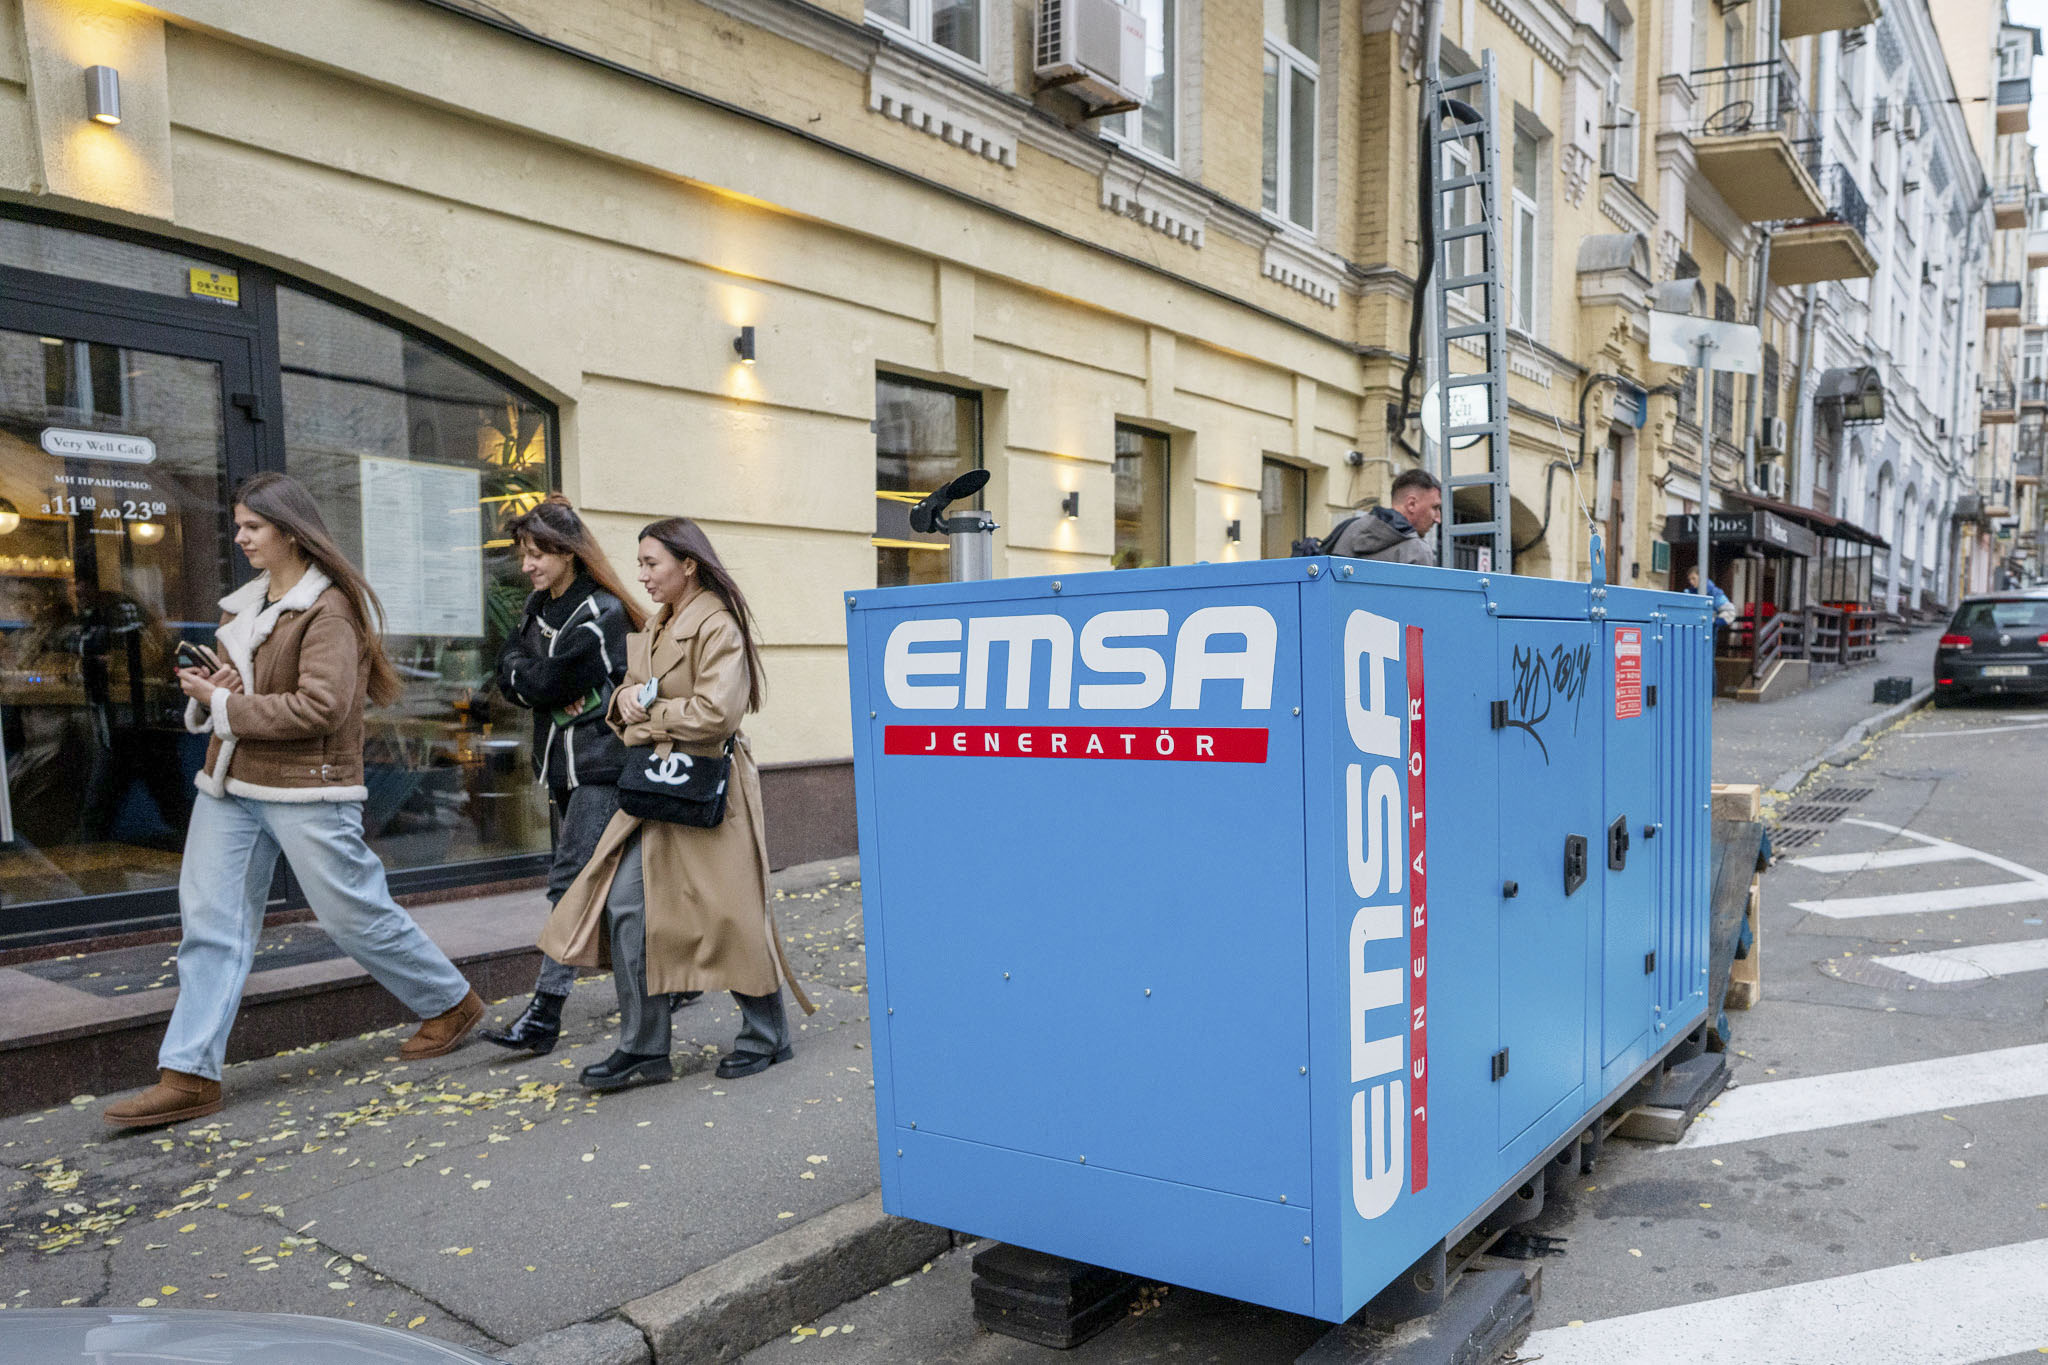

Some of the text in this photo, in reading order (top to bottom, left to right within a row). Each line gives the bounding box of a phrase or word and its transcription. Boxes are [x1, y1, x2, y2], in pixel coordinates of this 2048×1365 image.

[53, 436, 146, 455] Very Well Café
[1687, 515, 1748, 533] Nbos
[884, 605, 1278, 710] EMSA
[925, 729, 1215, 756] JENERATÖR
[1344, 609, 1404, 1220] EMSA
[1408, 696, 1426, 1122] JENERATÖR
